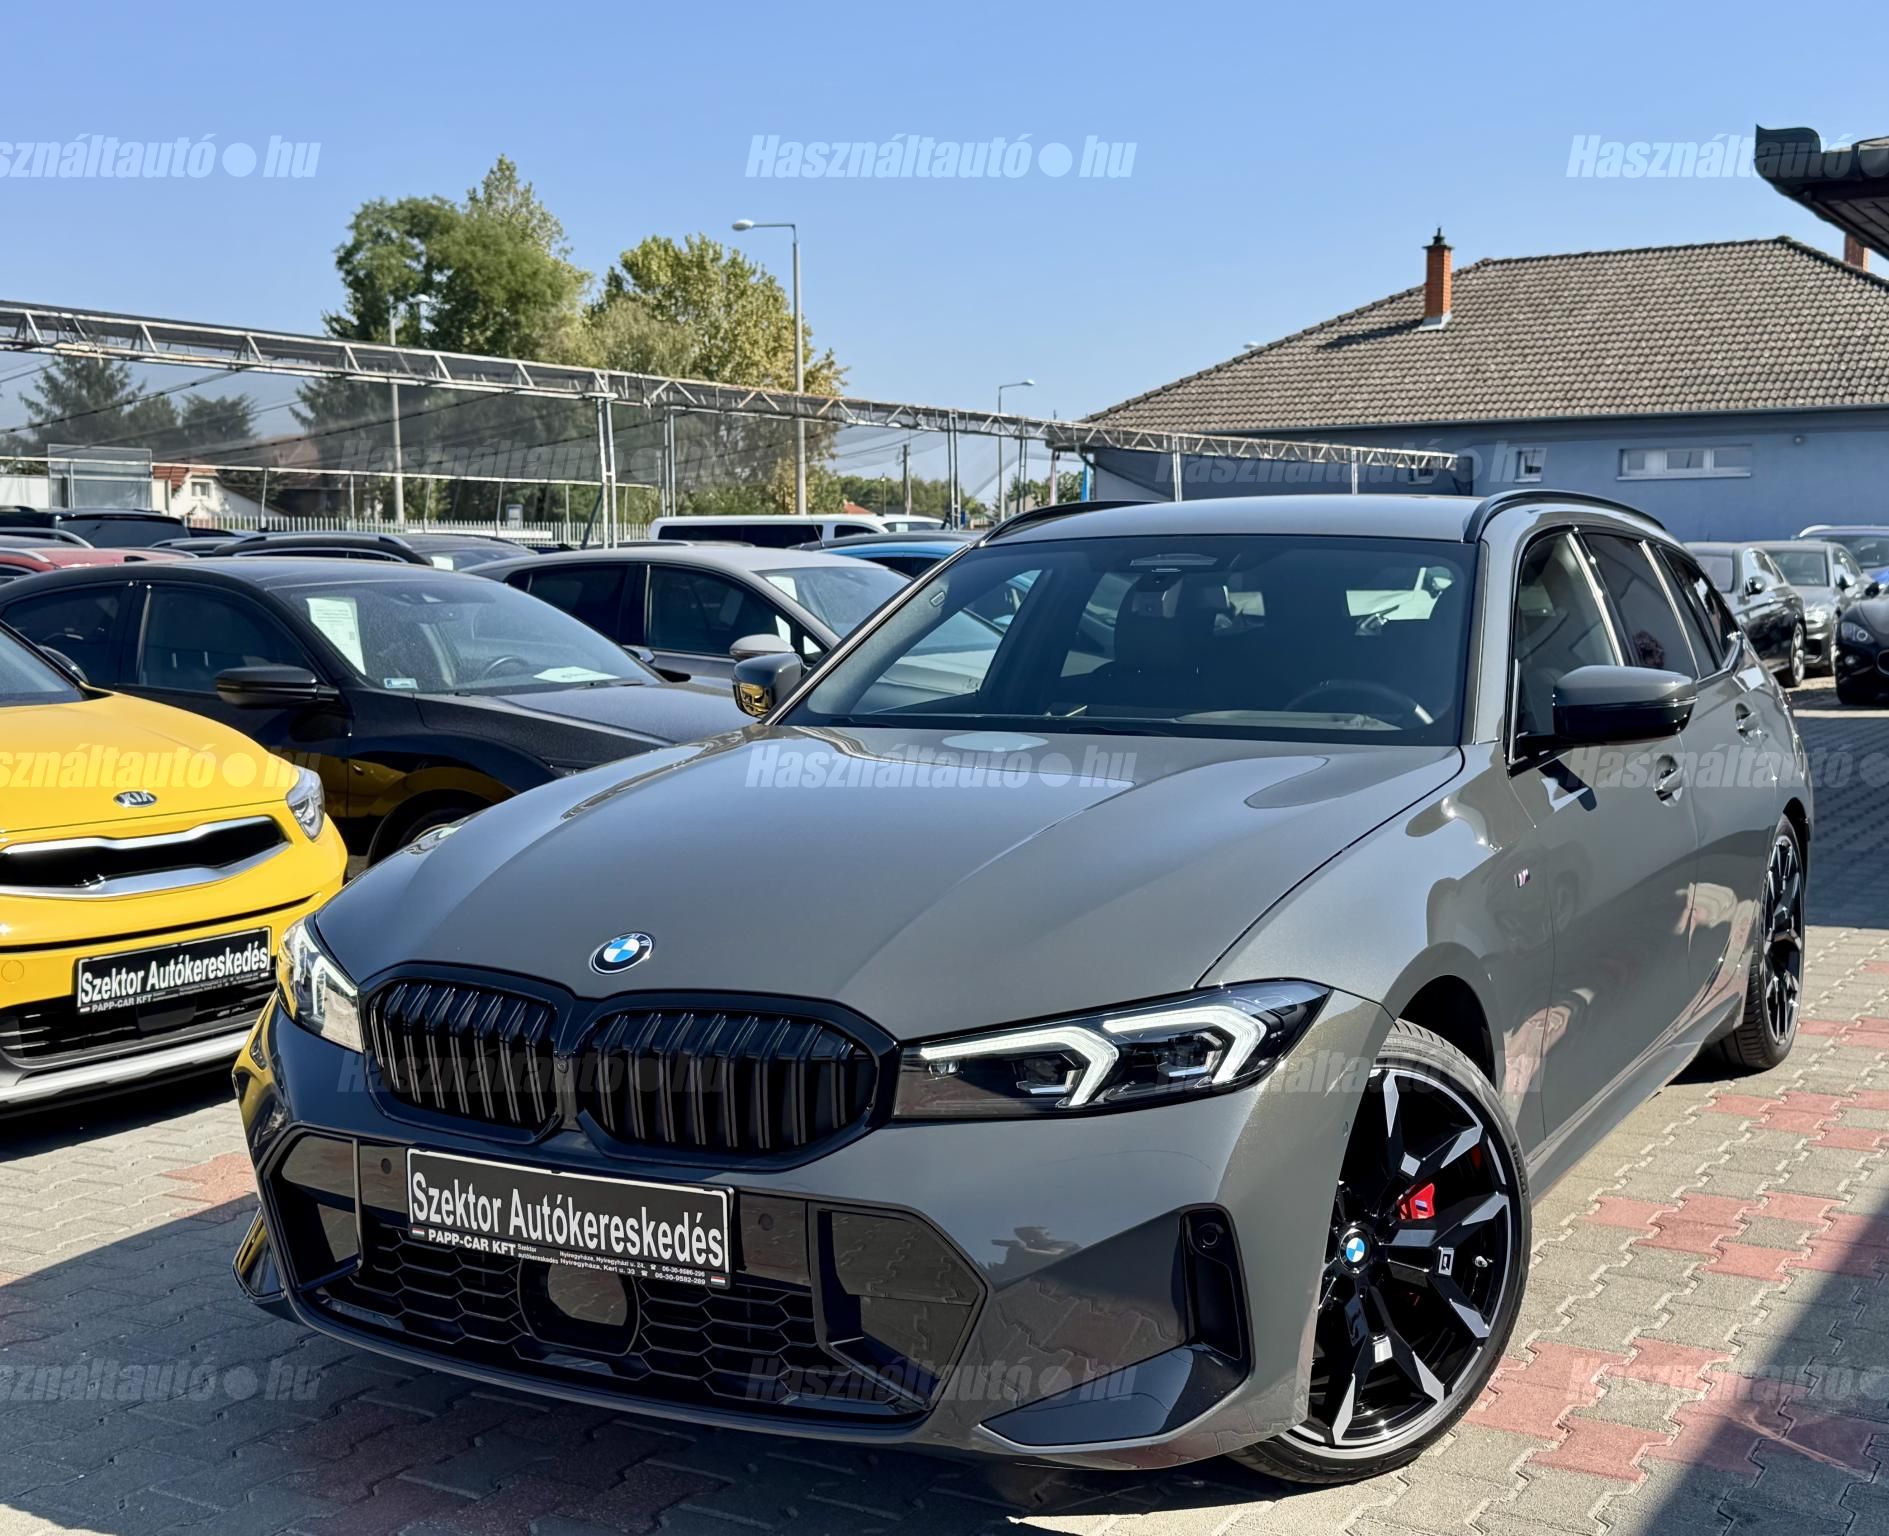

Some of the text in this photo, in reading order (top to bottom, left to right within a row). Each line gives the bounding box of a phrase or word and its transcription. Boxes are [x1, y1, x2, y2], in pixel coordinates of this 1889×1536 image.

[80, 967, 145, 1003] Szektor
[146, 940, 268, 991] Autókereskedés
[91, 994, 153, 1013] PAPP-CAR KFT
[412, 1171, 722, 1267] Szektor Autókereskedés
[428, 1228, 516, 1256] PAPP-CAR KFT
